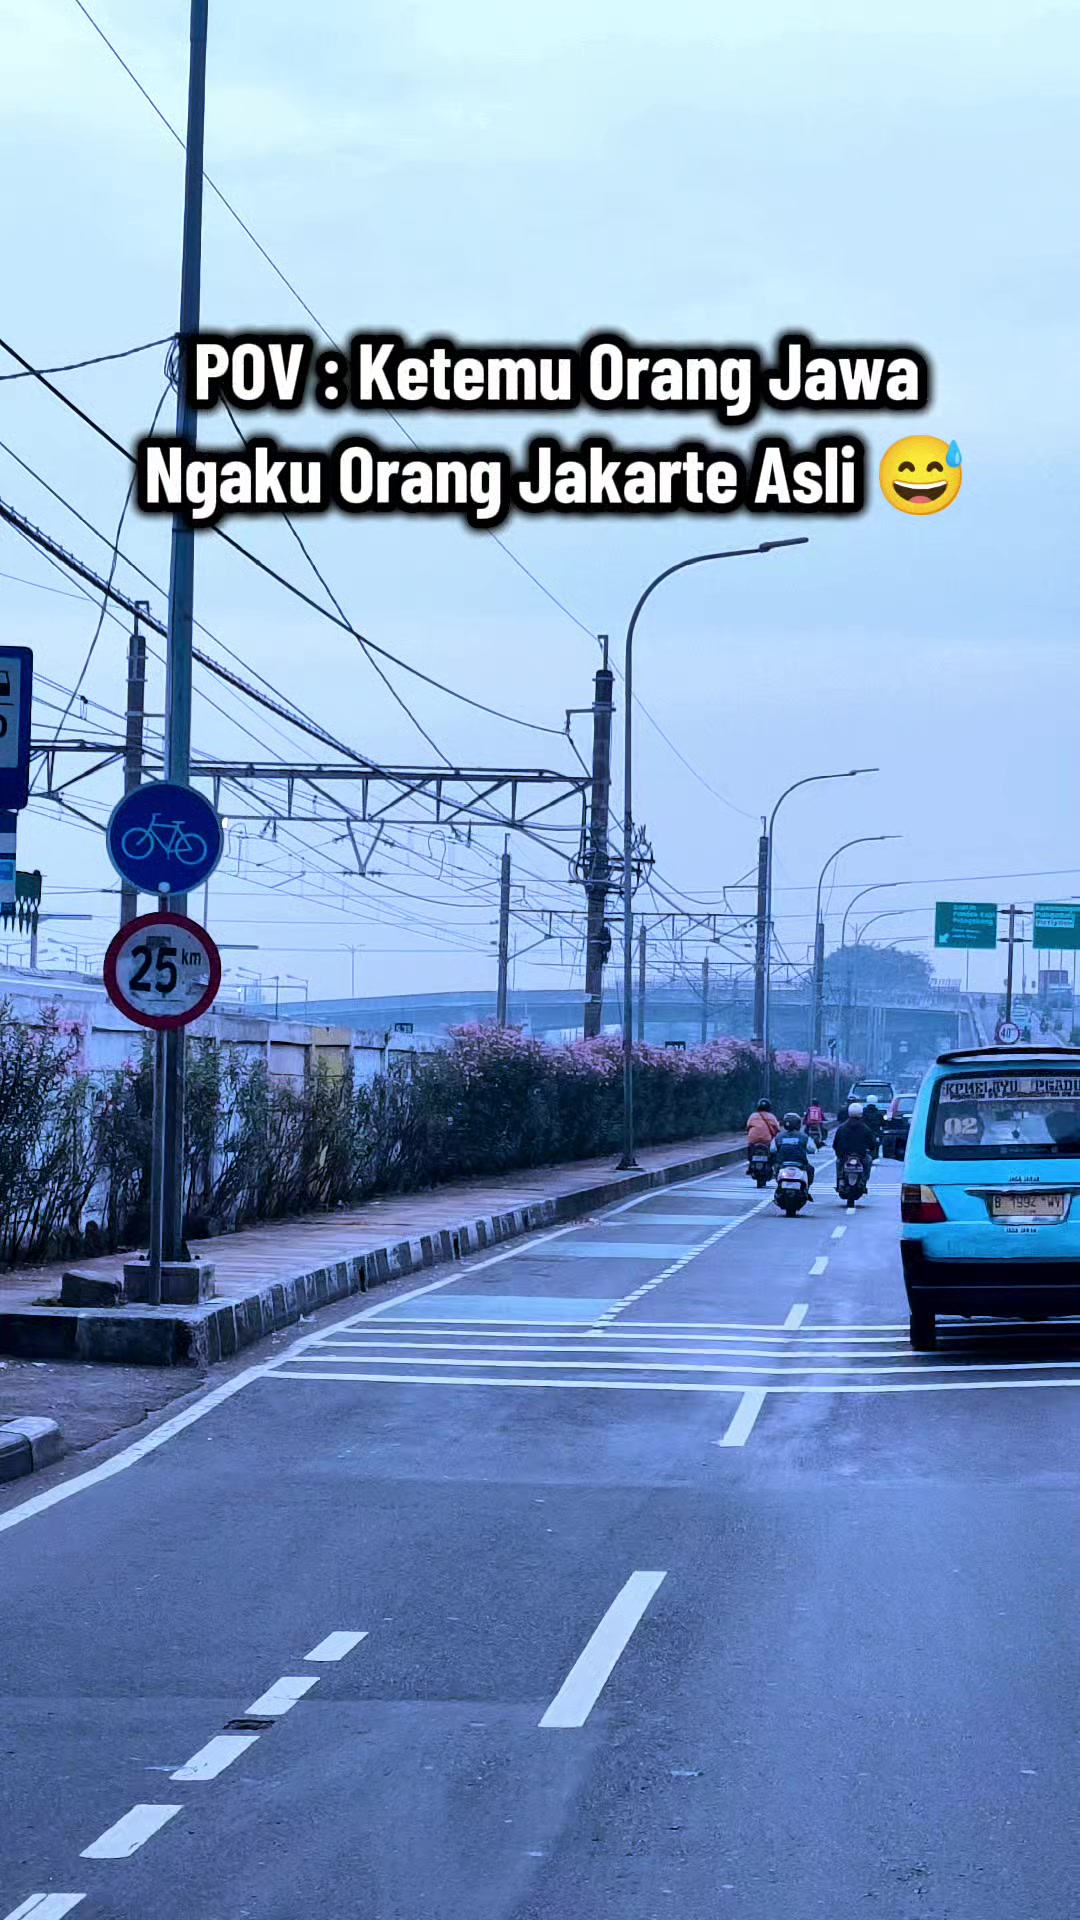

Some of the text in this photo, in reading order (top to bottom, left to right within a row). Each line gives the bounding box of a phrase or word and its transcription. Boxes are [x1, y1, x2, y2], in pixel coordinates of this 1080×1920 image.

[129, 944, 202, 994] 25 km
[944, 1117, 978, 1135] 02
[995, 1195, 1001, 1209] B
